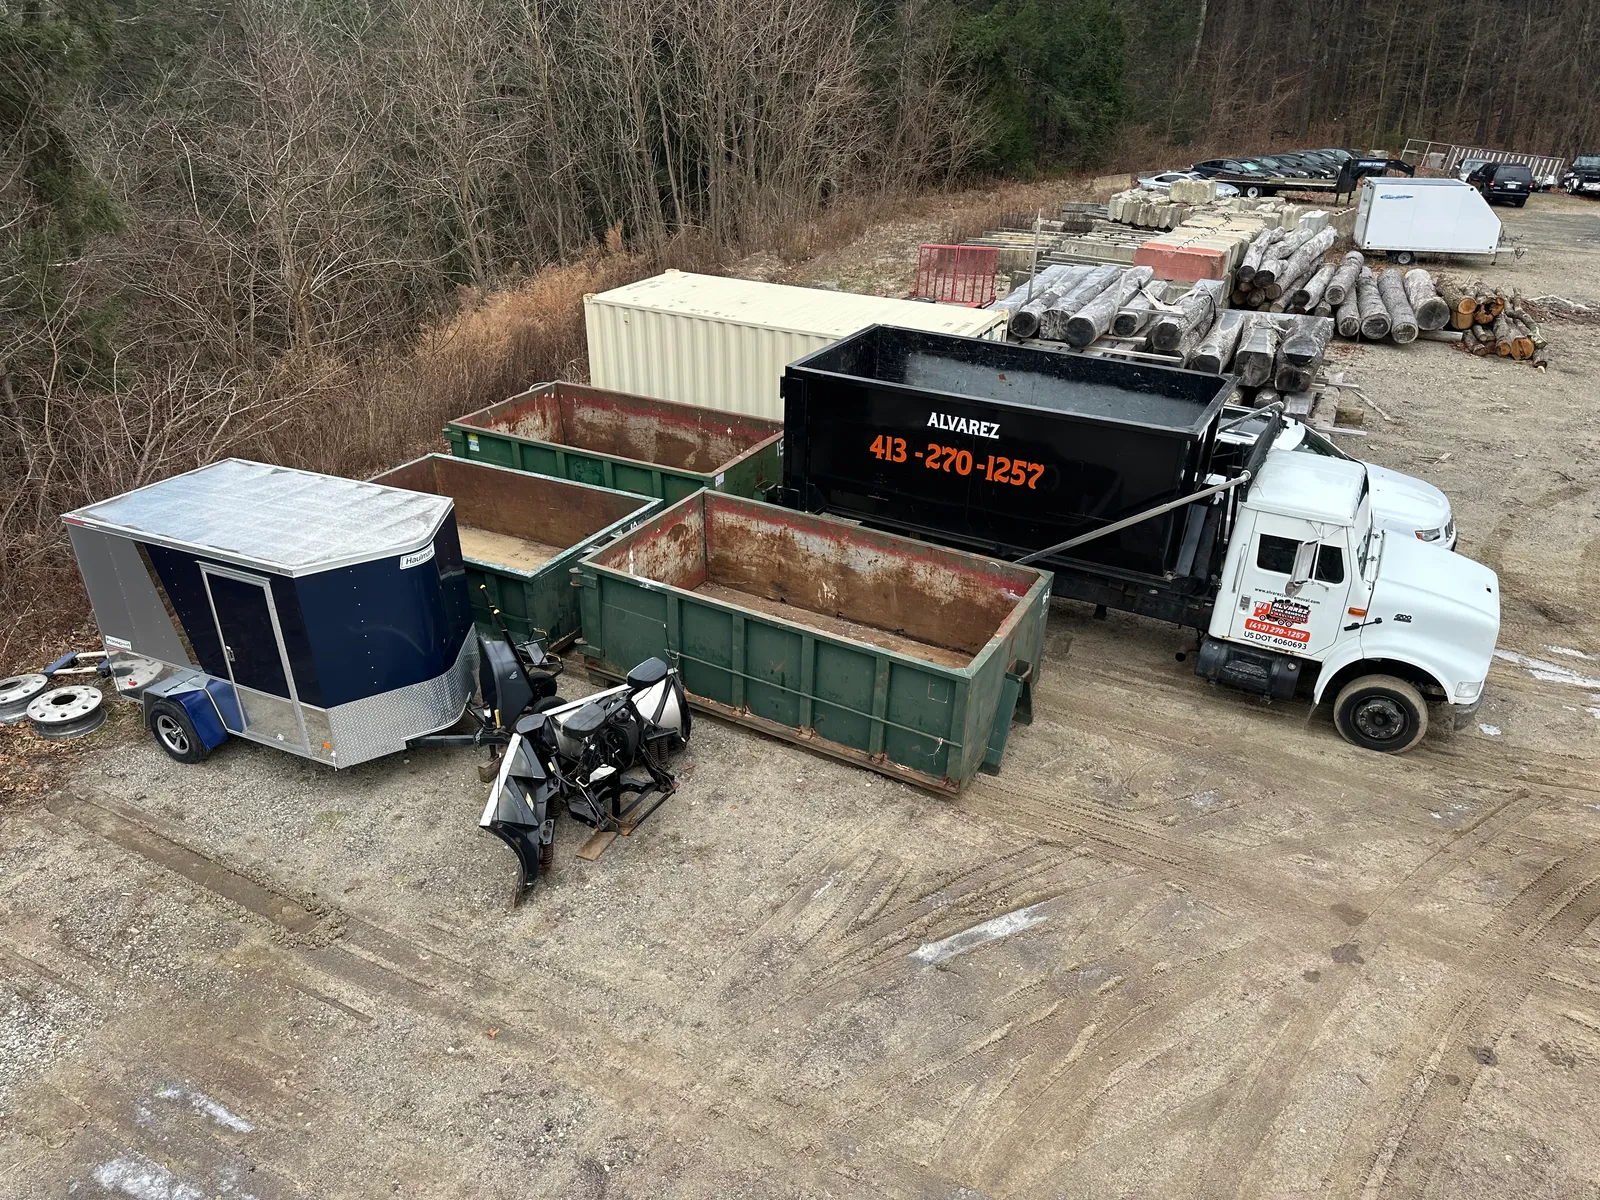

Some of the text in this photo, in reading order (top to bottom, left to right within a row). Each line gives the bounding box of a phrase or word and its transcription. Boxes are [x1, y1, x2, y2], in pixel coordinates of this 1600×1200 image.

[927, 411, 1000, 439] ALVAREZ
[1273, 602, 1309, 615] ALVAREZ
[1244, 630, 1307, 650] US DOT 4060693
[1249, 621, 1307, 640] (413) 270-1257
